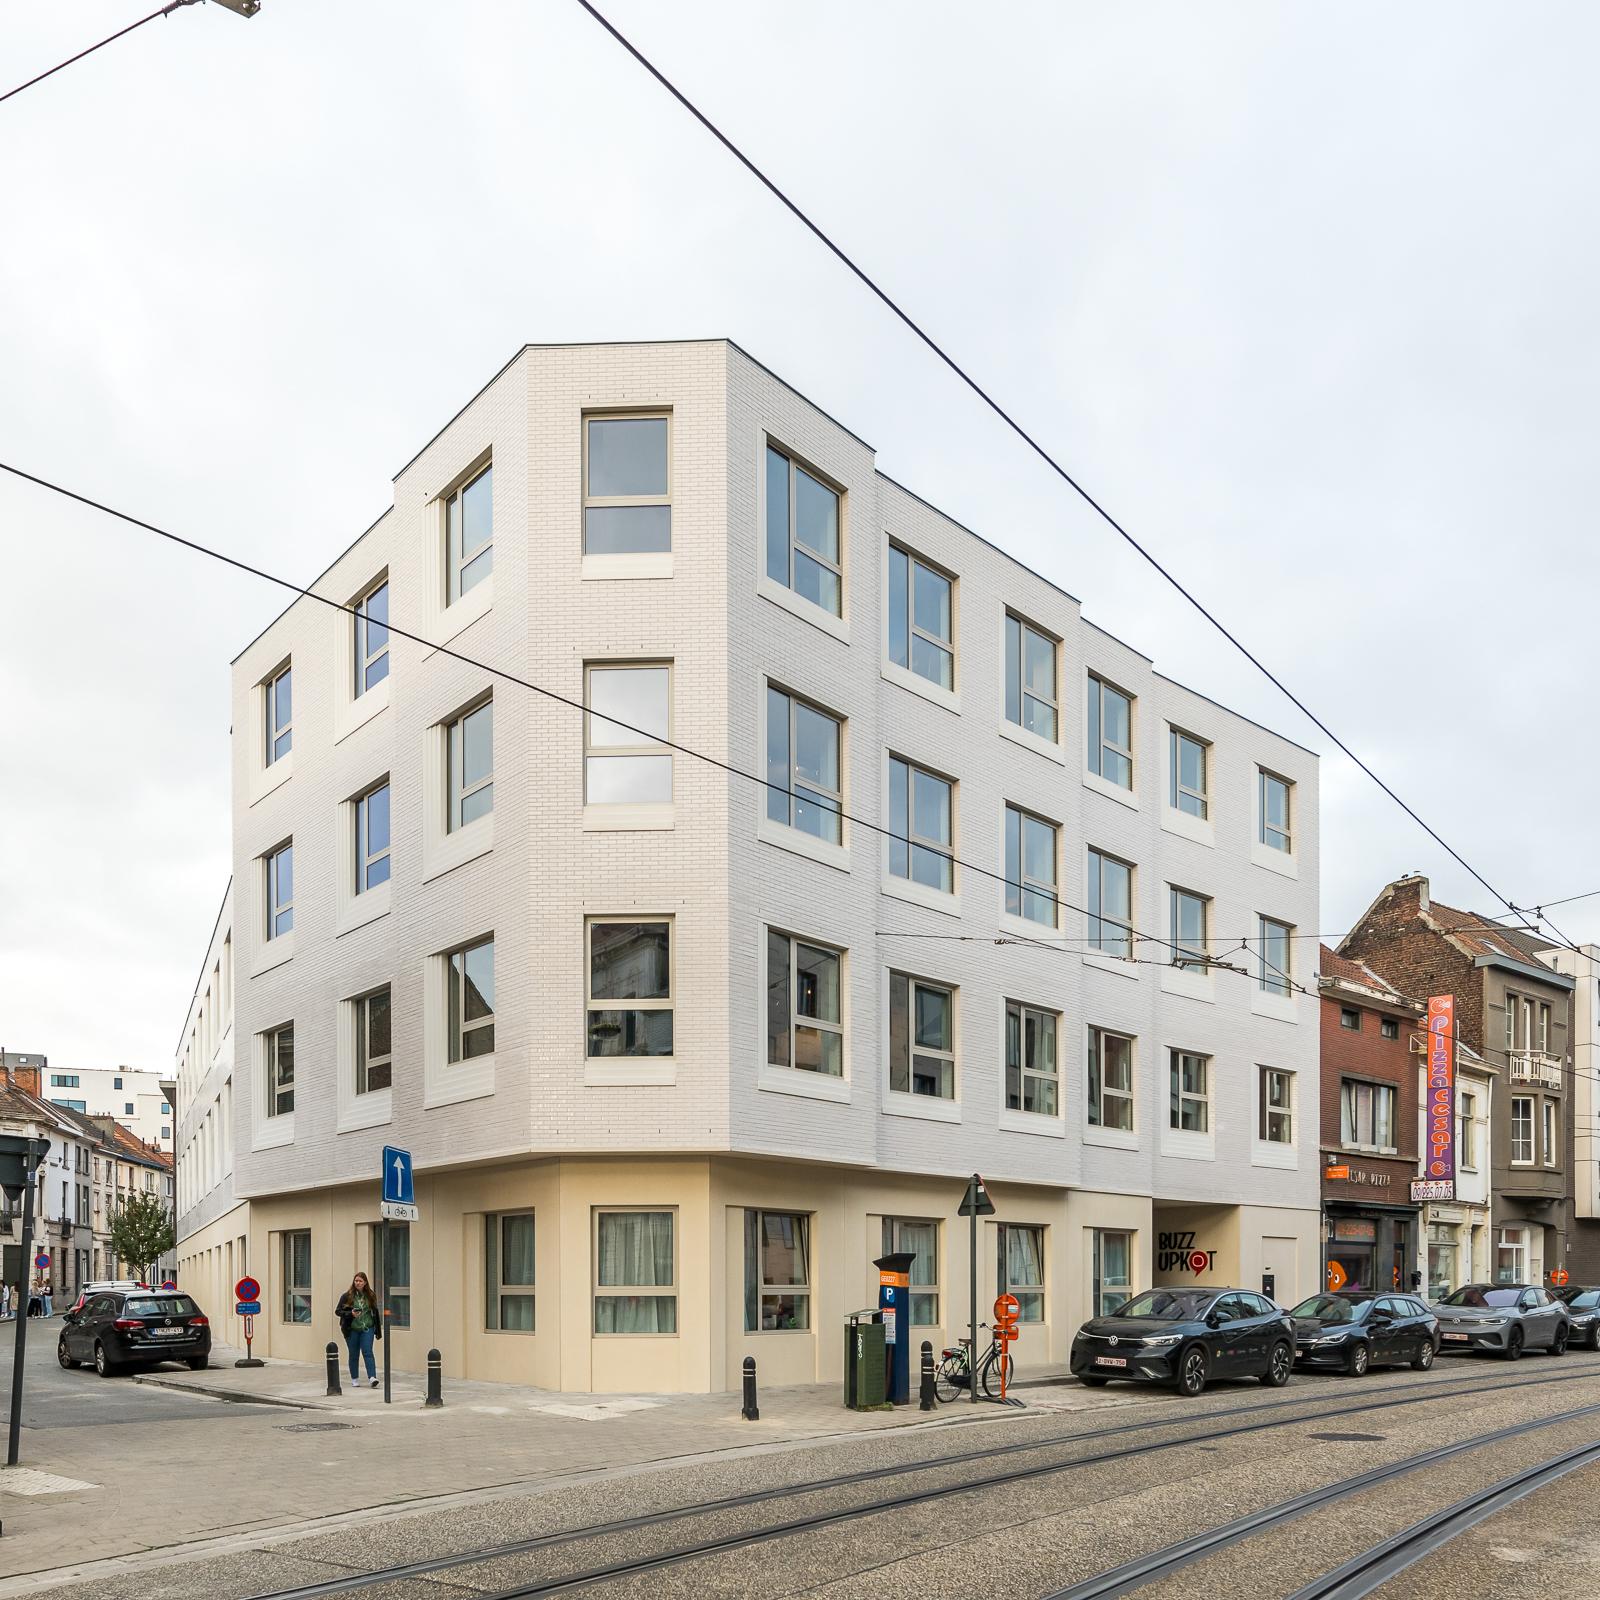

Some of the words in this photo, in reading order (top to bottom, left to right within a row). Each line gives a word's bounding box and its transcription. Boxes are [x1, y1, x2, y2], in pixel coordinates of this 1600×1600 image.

[1158, 1232, 1196, 1250] BUZZ
[1158, 1250, 1217, 1276] UPKOT
[886, 1288, 893, 1300] P
